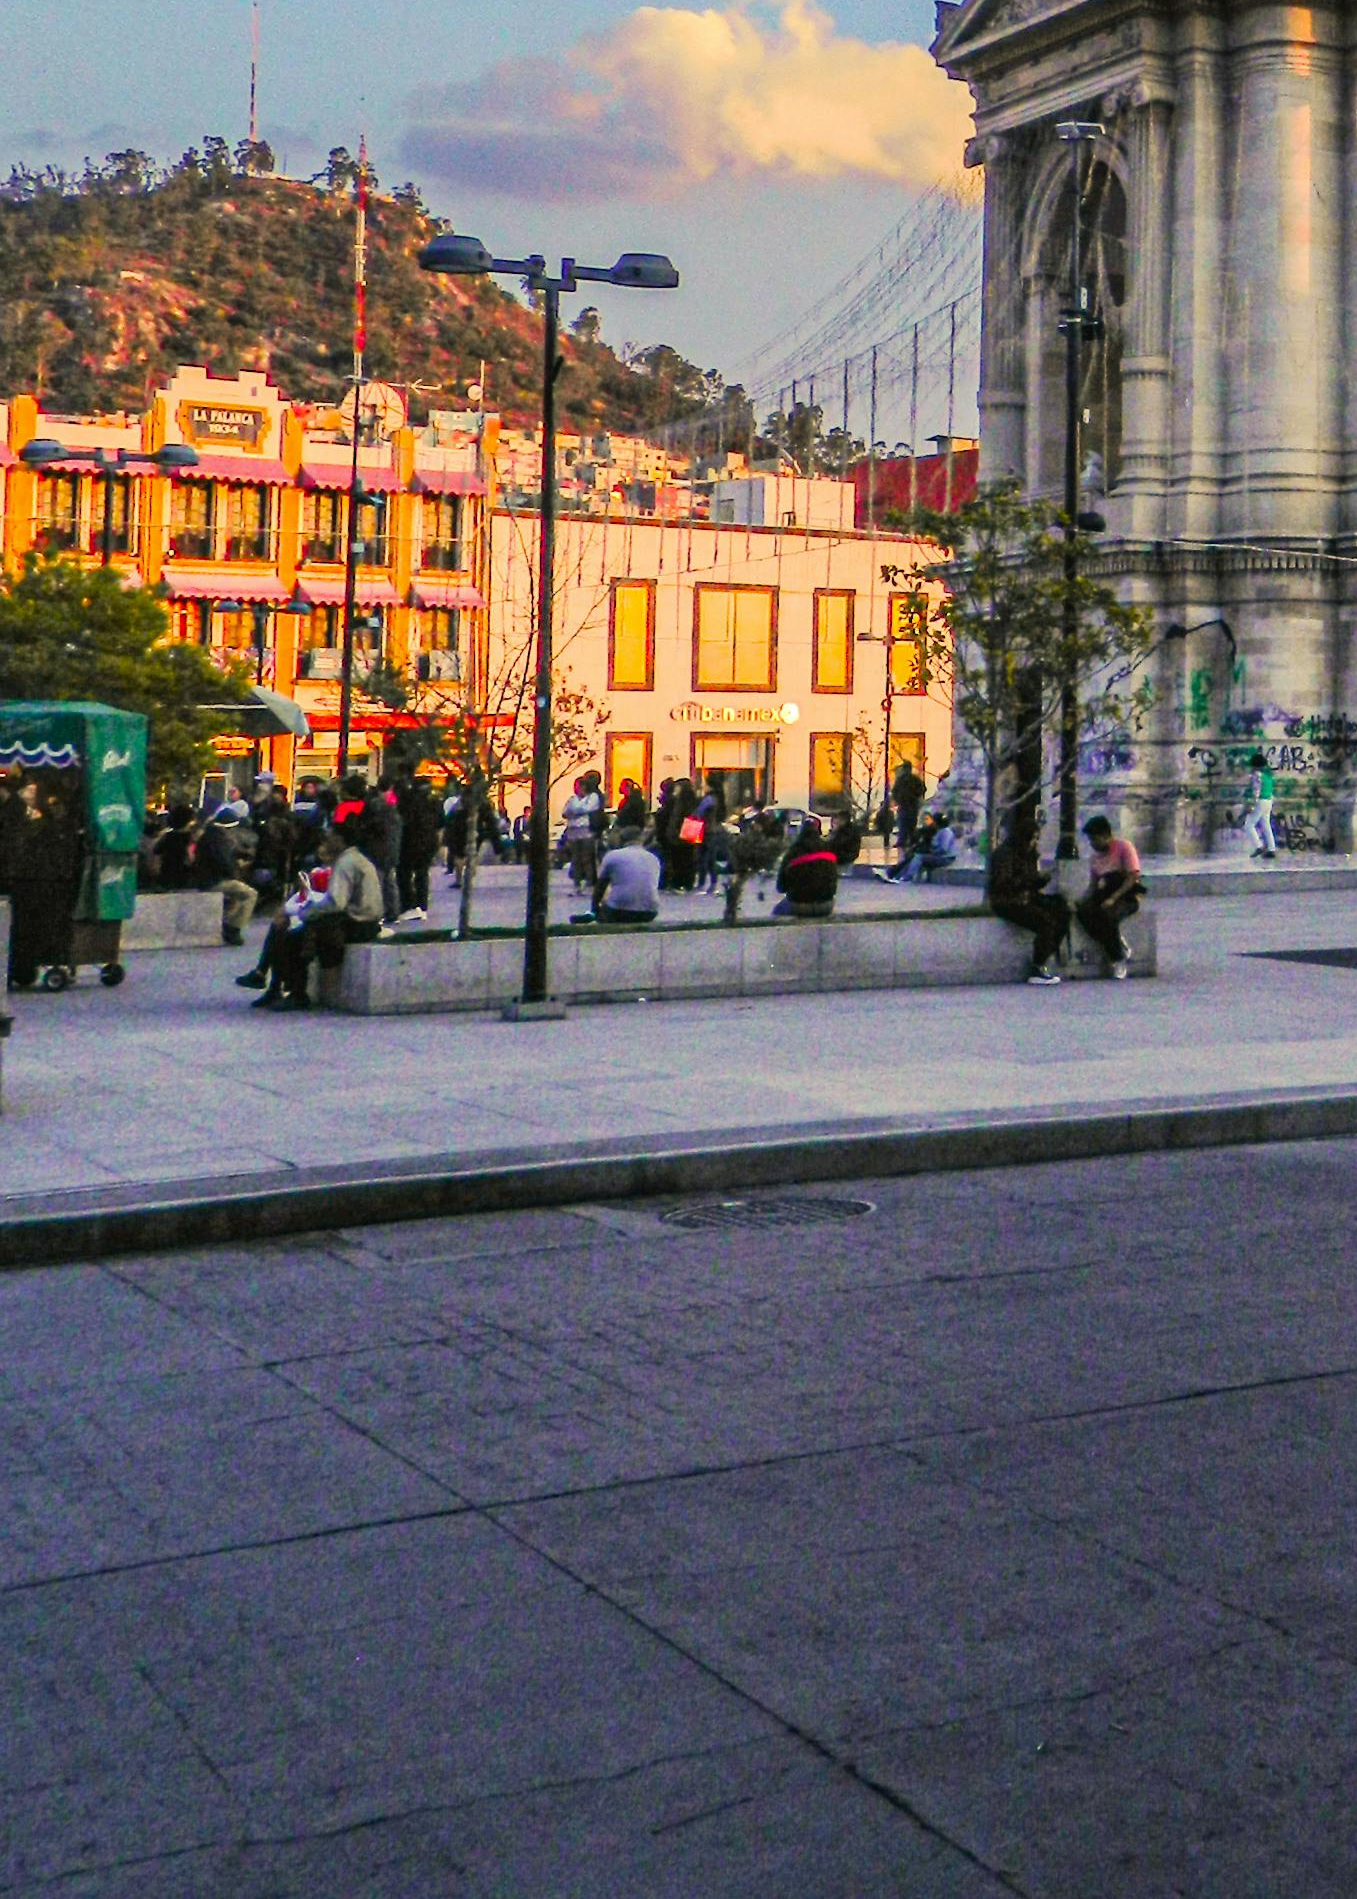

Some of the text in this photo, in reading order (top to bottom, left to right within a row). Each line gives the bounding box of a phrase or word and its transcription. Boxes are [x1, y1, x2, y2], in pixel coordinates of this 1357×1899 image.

[193, 408, 254, 426] LA PALANCA
[669, 700, 780, 722] citibanamex
